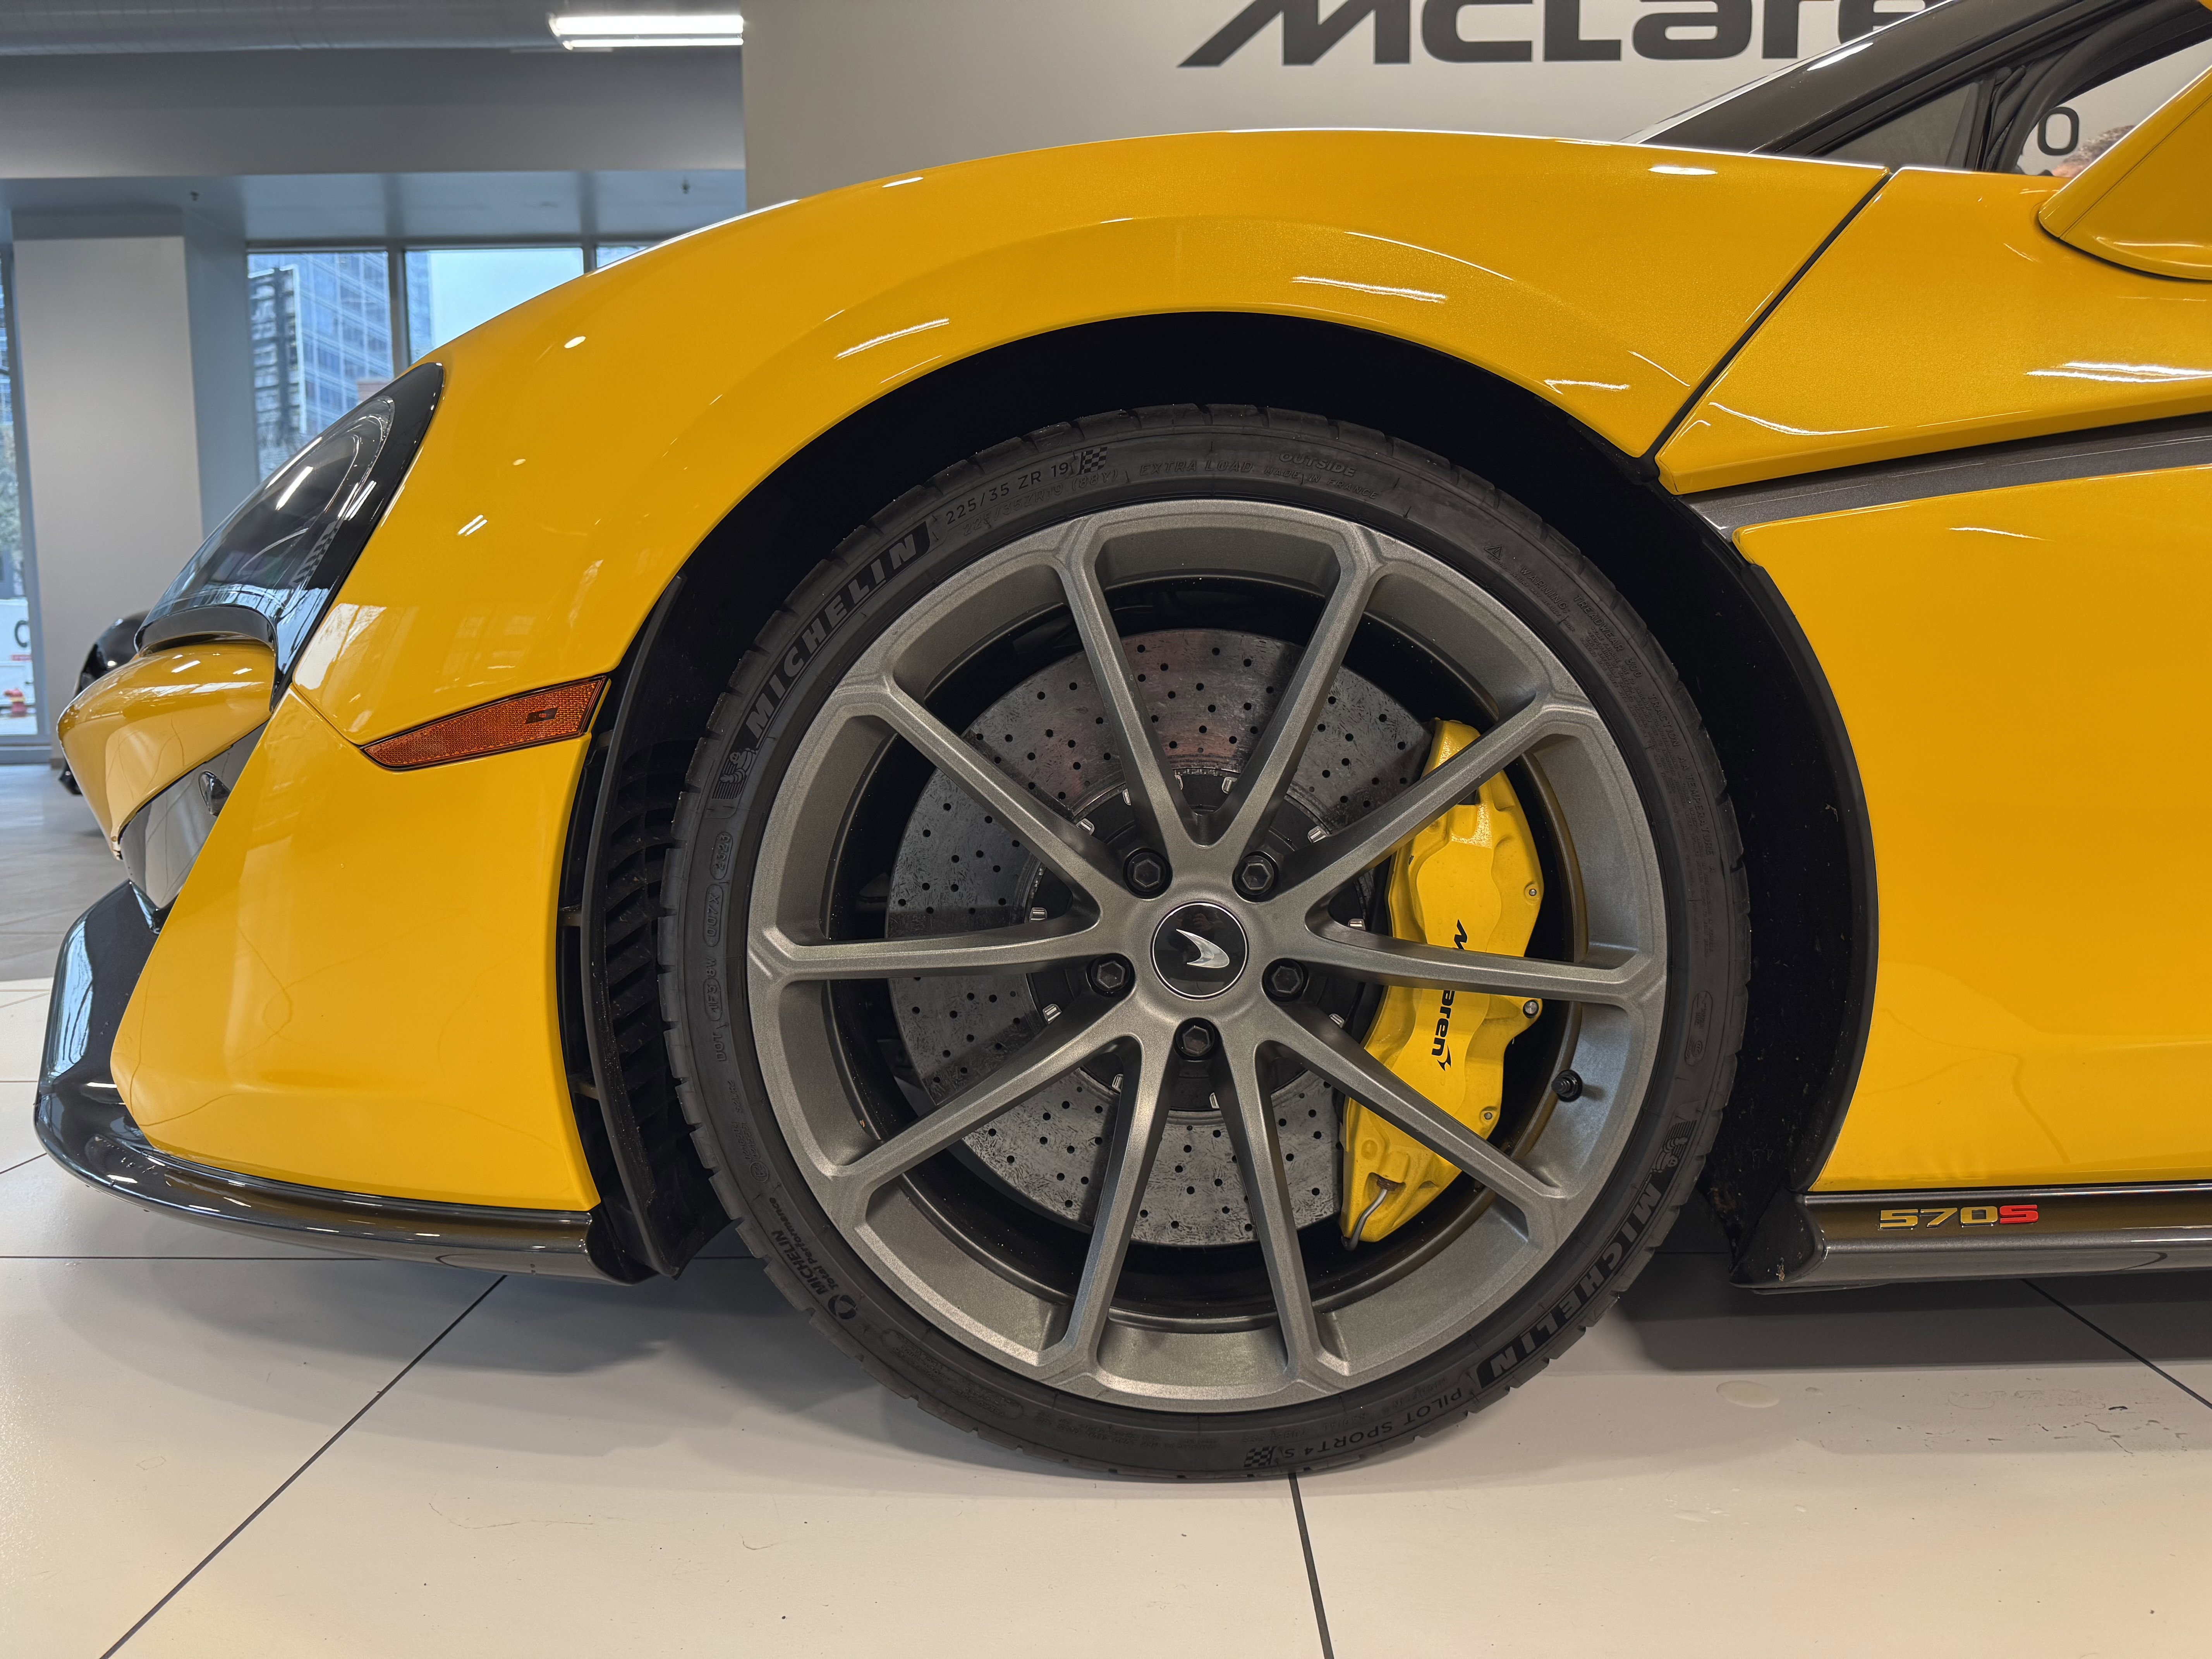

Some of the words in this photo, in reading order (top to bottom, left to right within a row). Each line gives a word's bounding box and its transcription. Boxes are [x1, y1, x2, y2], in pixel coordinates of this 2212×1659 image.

[1140, 460, 1197, 476] EXTRA
[1205, 459, 1253, 473] LOAD
[1264, 466, 1300, 479] MADE
[1306, 473, 1322, 484] IN
[1326, 477, 1379, 500] FRANCE
[1279, 451, 1357, 478] OUTSIDE
[945, 482, 1009, 525] 225/35
[1018, 469, 1041, 490] ZR
[1053, 461, 1067, 478] 19
[745, 531, 919, 739] MICHELIN
[1573, 595, 1625, 652] TREADWEAR
[1624, 658, 1643, 678] 300
[1647, 695, 1680, 747] TRACTION
[1677, 756, 1690, 769] AA
[1685, 776, 1714, 855] TEMPERATURE
[714, 833, 730, 870] 2323
[706, 891, 720, 937] 007X
[1431, 919, 1468, 1056] Maren
[711, 1032, 728, 1061] DOT
[765, 1199, 820, 1262] Performance
[1879, 1204, 2039, 1228] 570S
[769, 1231, 831, 1293] MICHELIN
[814, 1267, 841, 1288] Total
[1489, 1183, 1664, 1377] MICHELIN
[1403, 1387, 1461, 1425] PILOT
[1285, 1448, 1294, 1458] S
[1304, 1446, 1313, 1456] 4
[1317, 1420, 1391, 1453] SPORT
